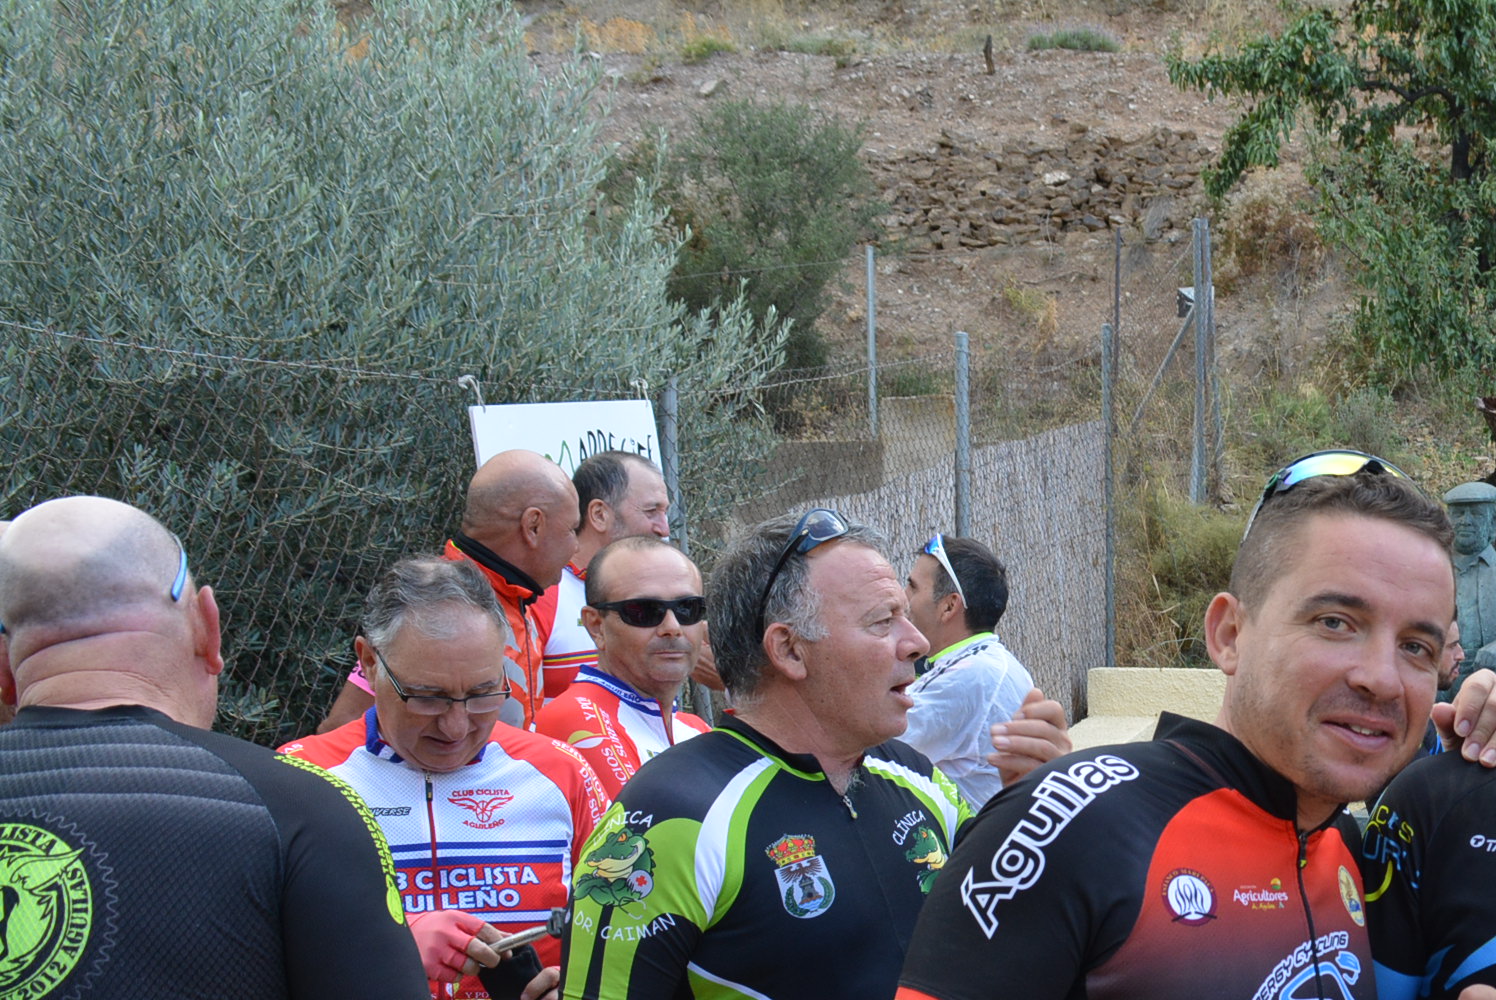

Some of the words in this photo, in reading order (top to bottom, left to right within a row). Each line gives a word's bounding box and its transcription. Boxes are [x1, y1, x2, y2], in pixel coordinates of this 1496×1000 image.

[452, 790, 474, 798] CLUB
[476, 788, 511, 797] CICLISTA
[892, 809, 927, 846] CLÍNICA
[414, 865, 540, 891] CICLISTA
[1233, 888, 1289, 906] Agricultores
[64, 866, 91, 959] AGUILAS
[600, 912, 677, 942] CAIMAN
